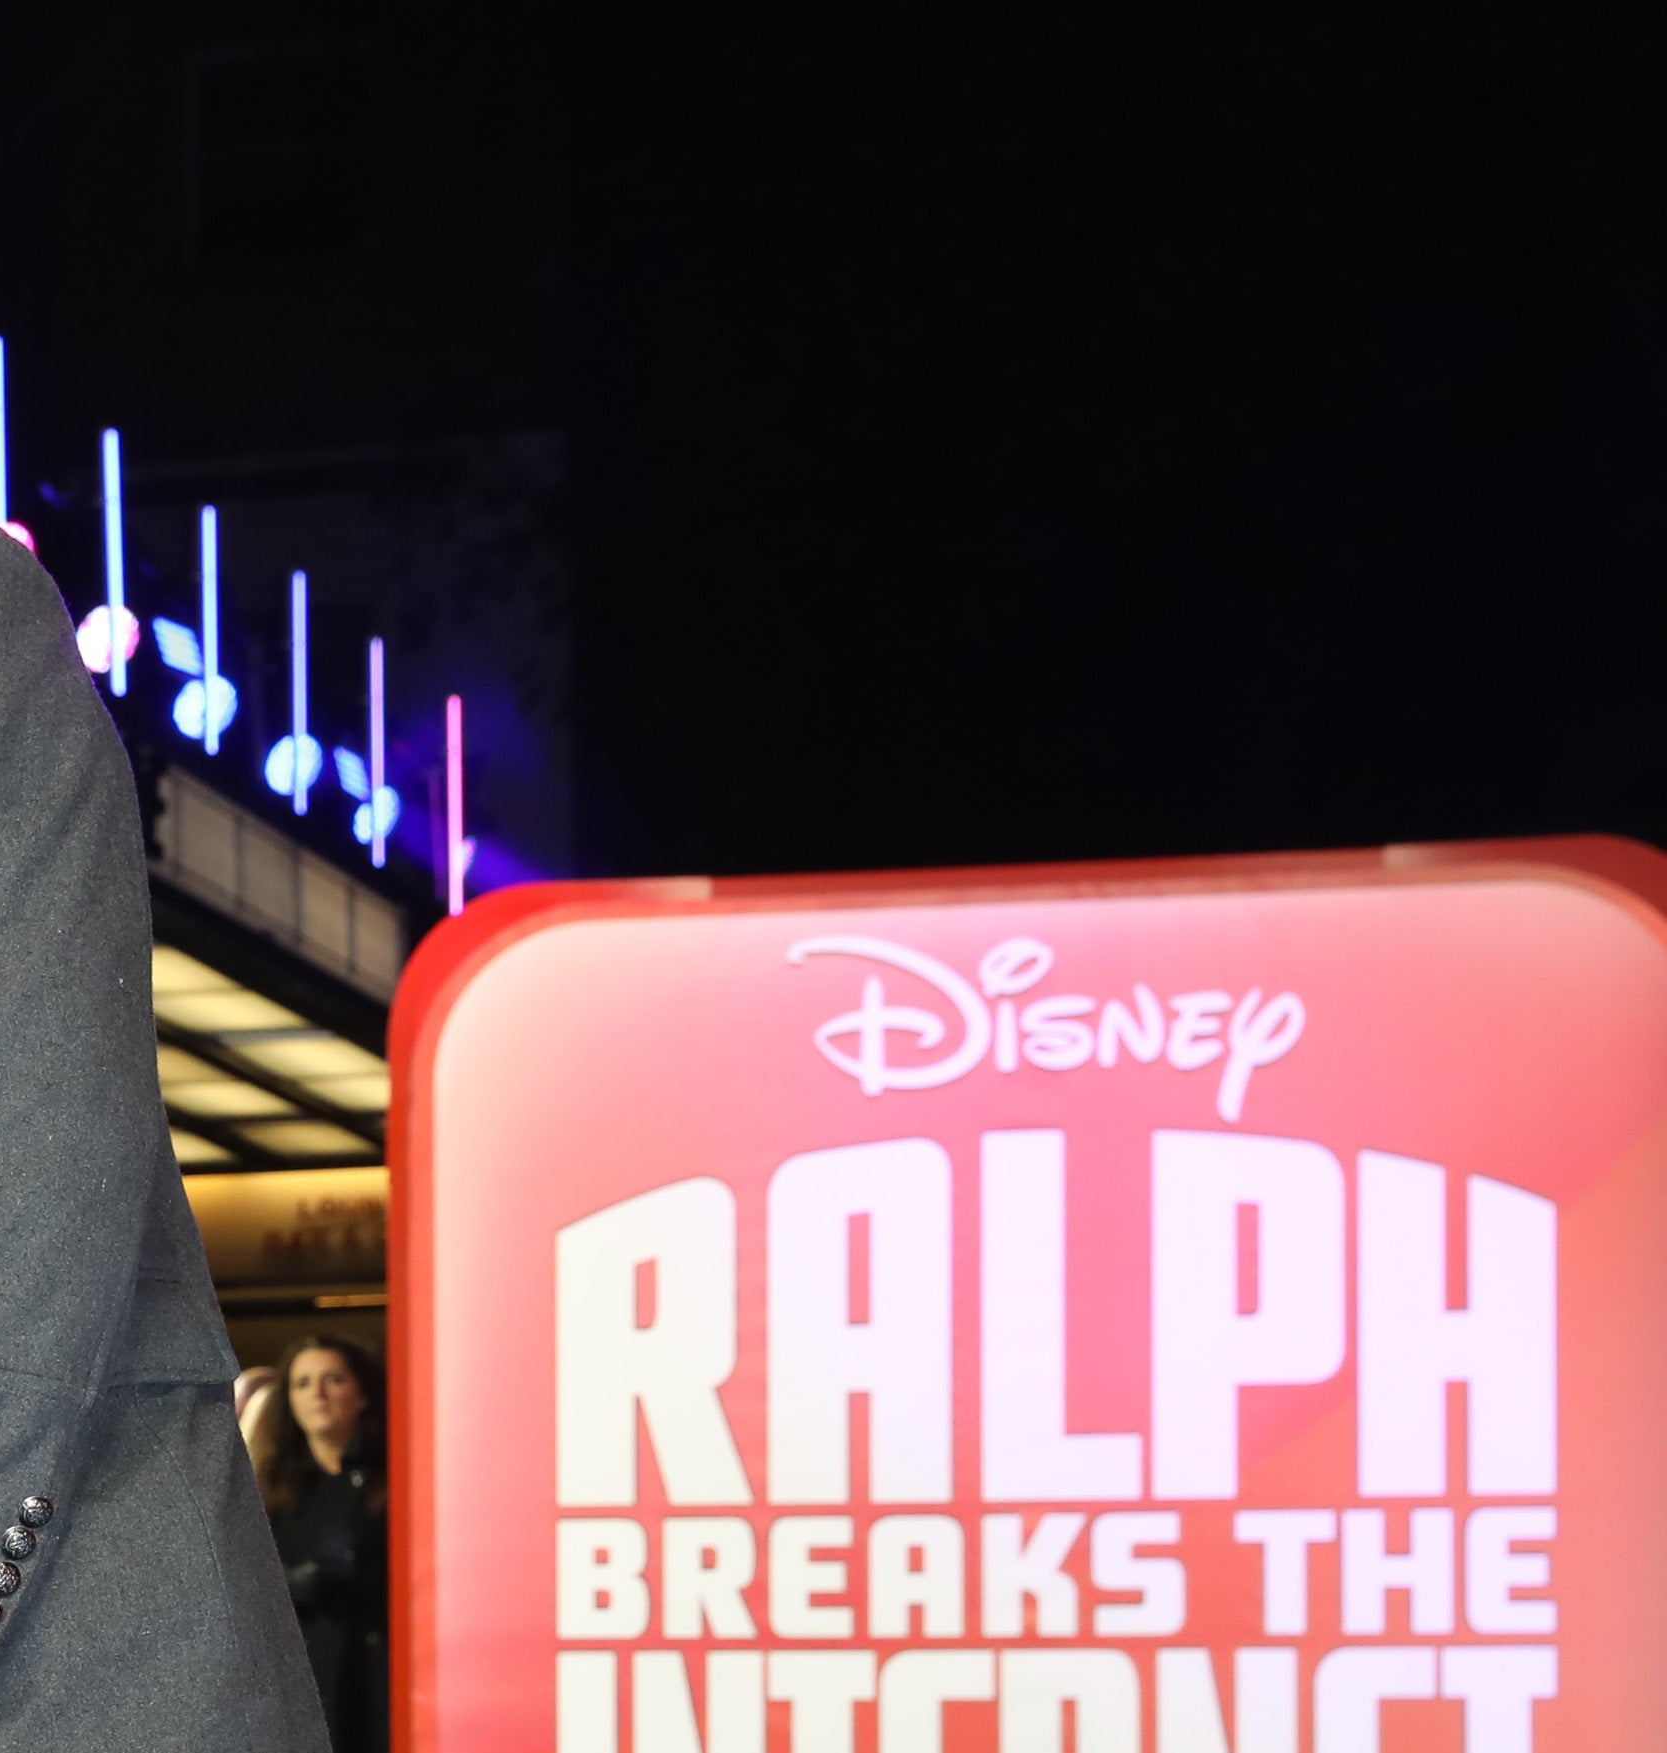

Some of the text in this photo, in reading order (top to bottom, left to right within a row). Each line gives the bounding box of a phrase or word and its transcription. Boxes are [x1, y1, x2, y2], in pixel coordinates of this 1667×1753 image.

[555, 1128, 1558, 1506] RALPH
[555, 1507, 1558, 1641] BREAKS THE
